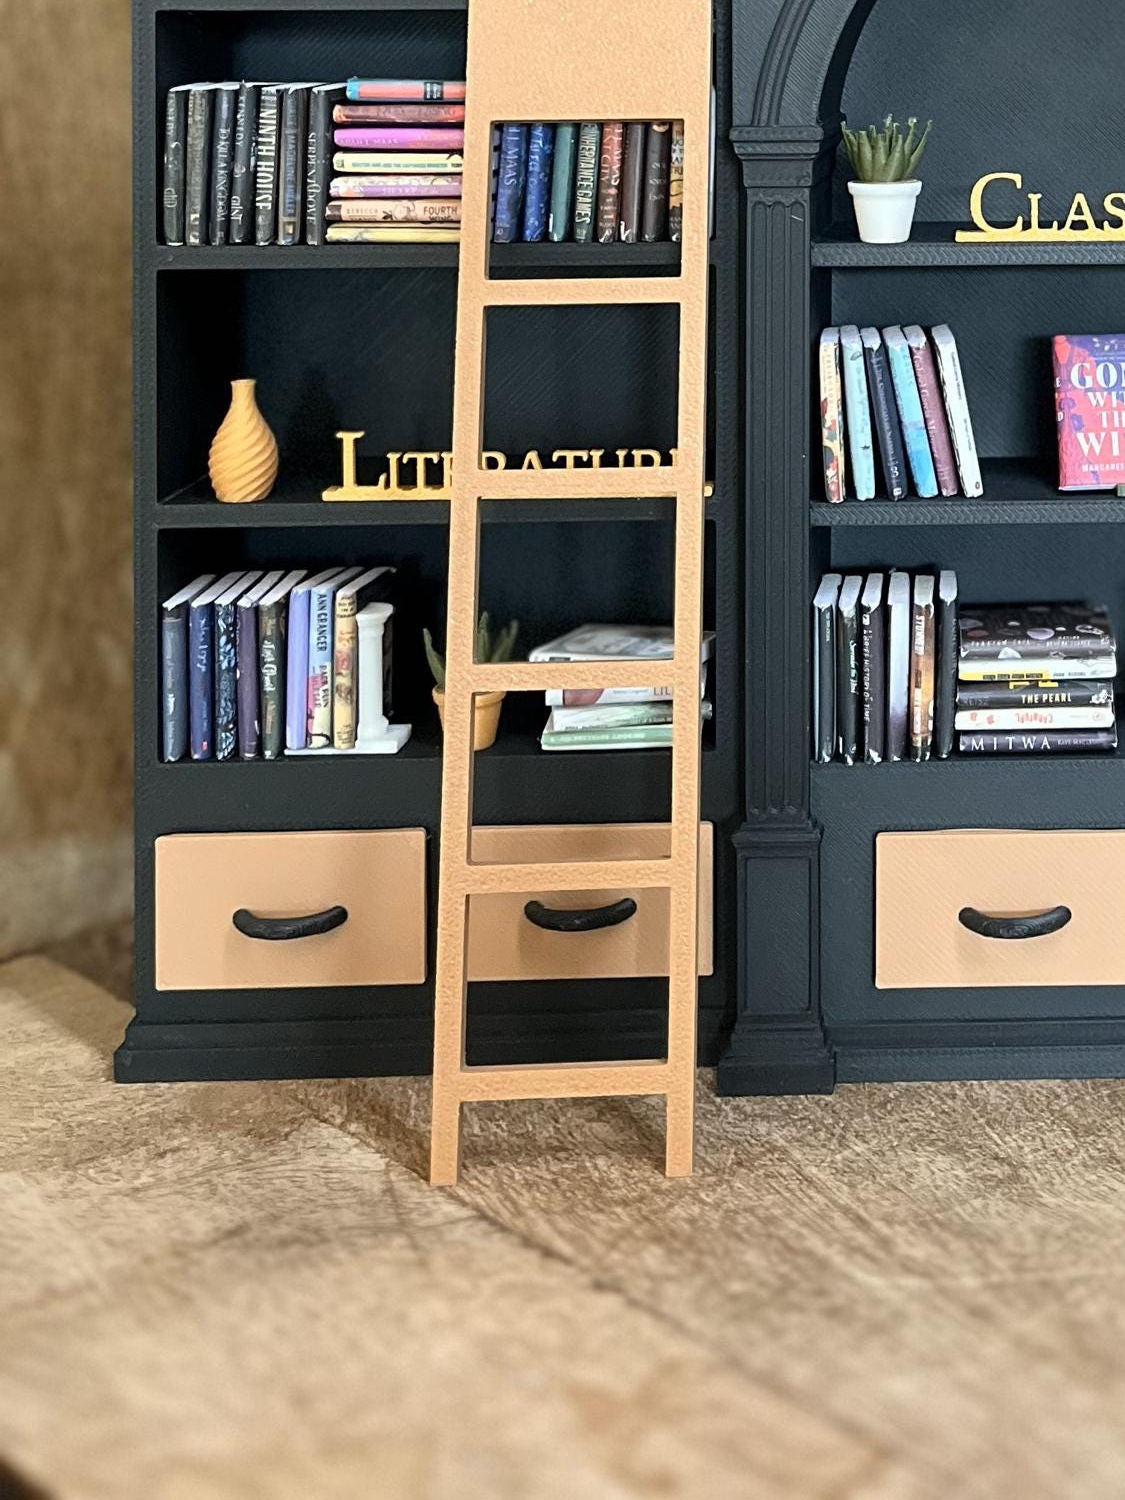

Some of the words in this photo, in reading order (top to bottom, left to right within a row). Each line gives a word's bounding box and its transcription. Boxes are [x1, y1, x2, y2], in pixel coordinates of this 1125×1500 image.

[257, 109, 277, 157] NINTH
[255, 161, 275, 210] HOUSE
[424, 206, 457, 216] FOURTH
[575, 191, 592, 224] GAMES
[335, 431, 678, 490] LITRATUR
[316, 612, 328, 652] GRANGER
[1021, 694, 1039, 704] THE
[1042, 693, 1072, 703] PEARL
[971, 735, 1051, 750] MITWA
